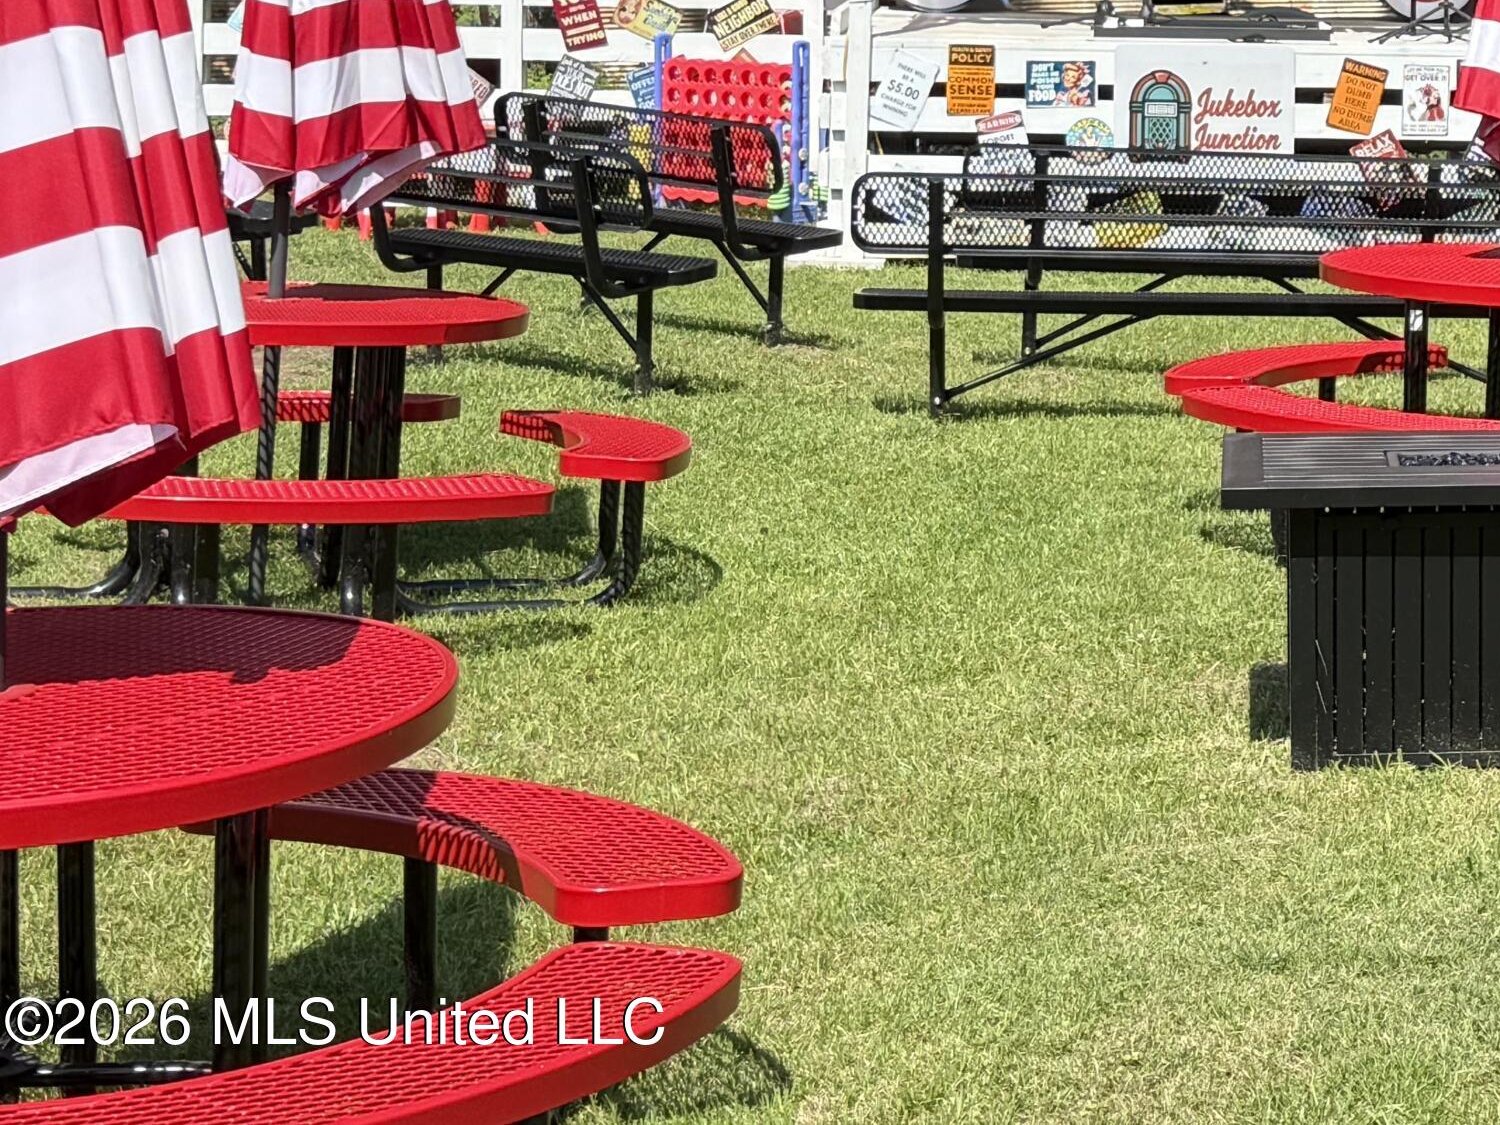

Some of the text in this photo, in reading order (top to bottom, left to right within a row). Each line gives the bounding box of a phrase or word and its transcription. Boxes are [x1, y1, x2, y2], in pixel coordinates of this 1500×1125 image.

[561, 11, 598, 26] WHEN
[566, 31, 605, 46] TRYING
[722, 36, 738, 49] STAY
[951, 53, 992, 63] POLICY
[898, 63, 913, 75] THERE
[1032, 63, 1054, 72] DON'T
[1345, 61, 1386, 81] WARNING
[949, 76, 993, 84] COMMON
[1346, 76, 1378, 91] DO NOT
[888, 79, 920, 100] $5.00
[950, 85, 992, 95] SENSE
[1028, 90, 1056, 101] FOOD
[1346, 87, 1372, 100] DUMB
[881, 93, 916, 110] CHARGE FOR
[1194, 87, 1282, 124] Jukebox
[1344, 97, 1368, 110] HERE
[1334, 106, 1373, 123] NO DUMB
[980, 115, 1021, 129] WARNING
[1338, 118, 1360, 130] AREA
[1194, 123, 1281, 151] Junction
[1355, 134, 1393, 157] RELAX
